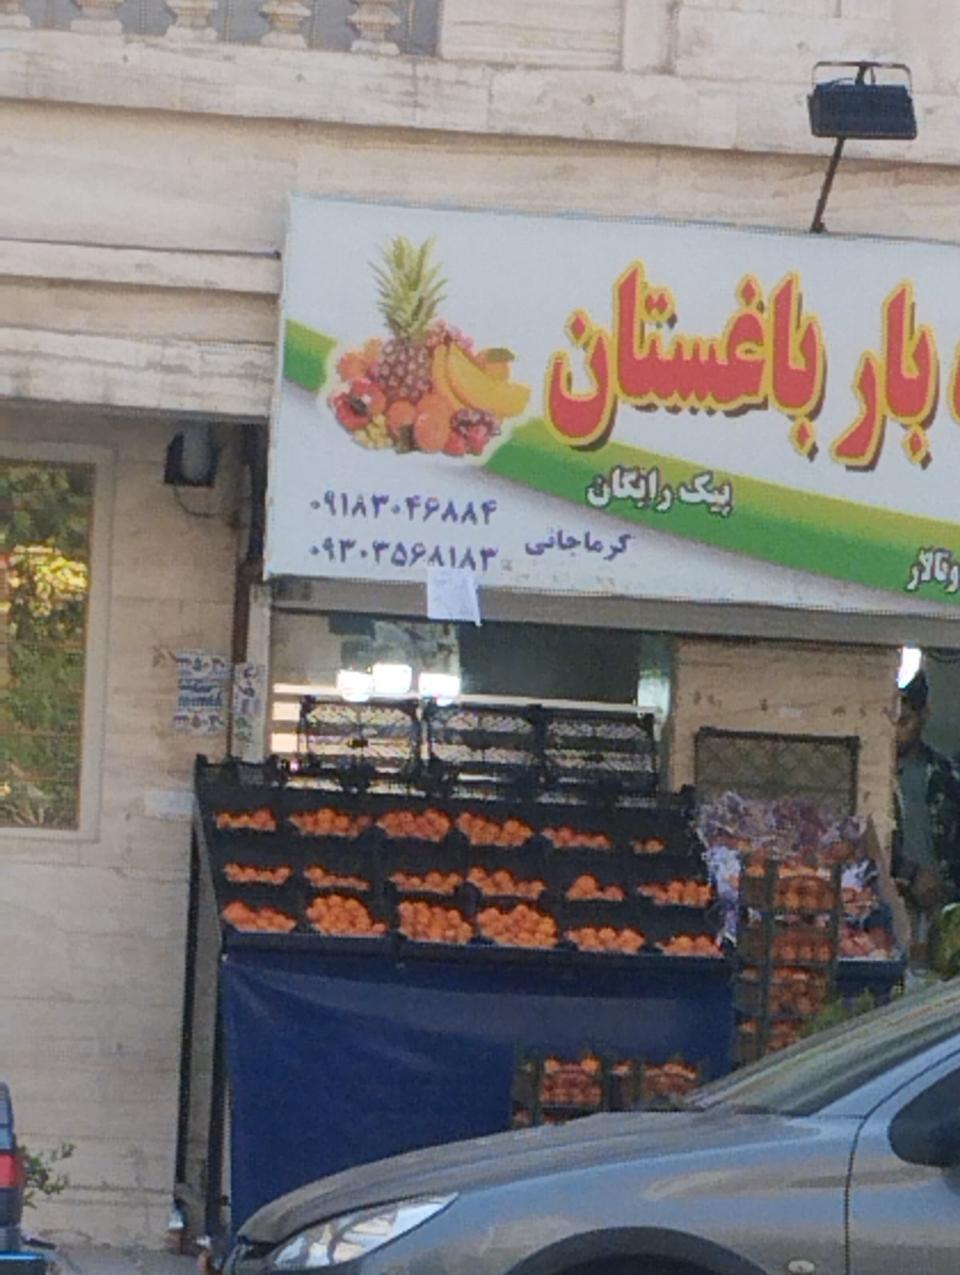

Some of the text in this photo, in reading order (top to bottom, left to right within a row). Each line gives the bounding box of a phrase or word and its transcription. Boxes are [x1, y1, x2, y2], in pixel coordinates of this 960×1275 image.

[545, 257, 827, 463] باغستان
[831, 280, 940, 471] بار
[585, 464, 733, 517] پیک رایگان
